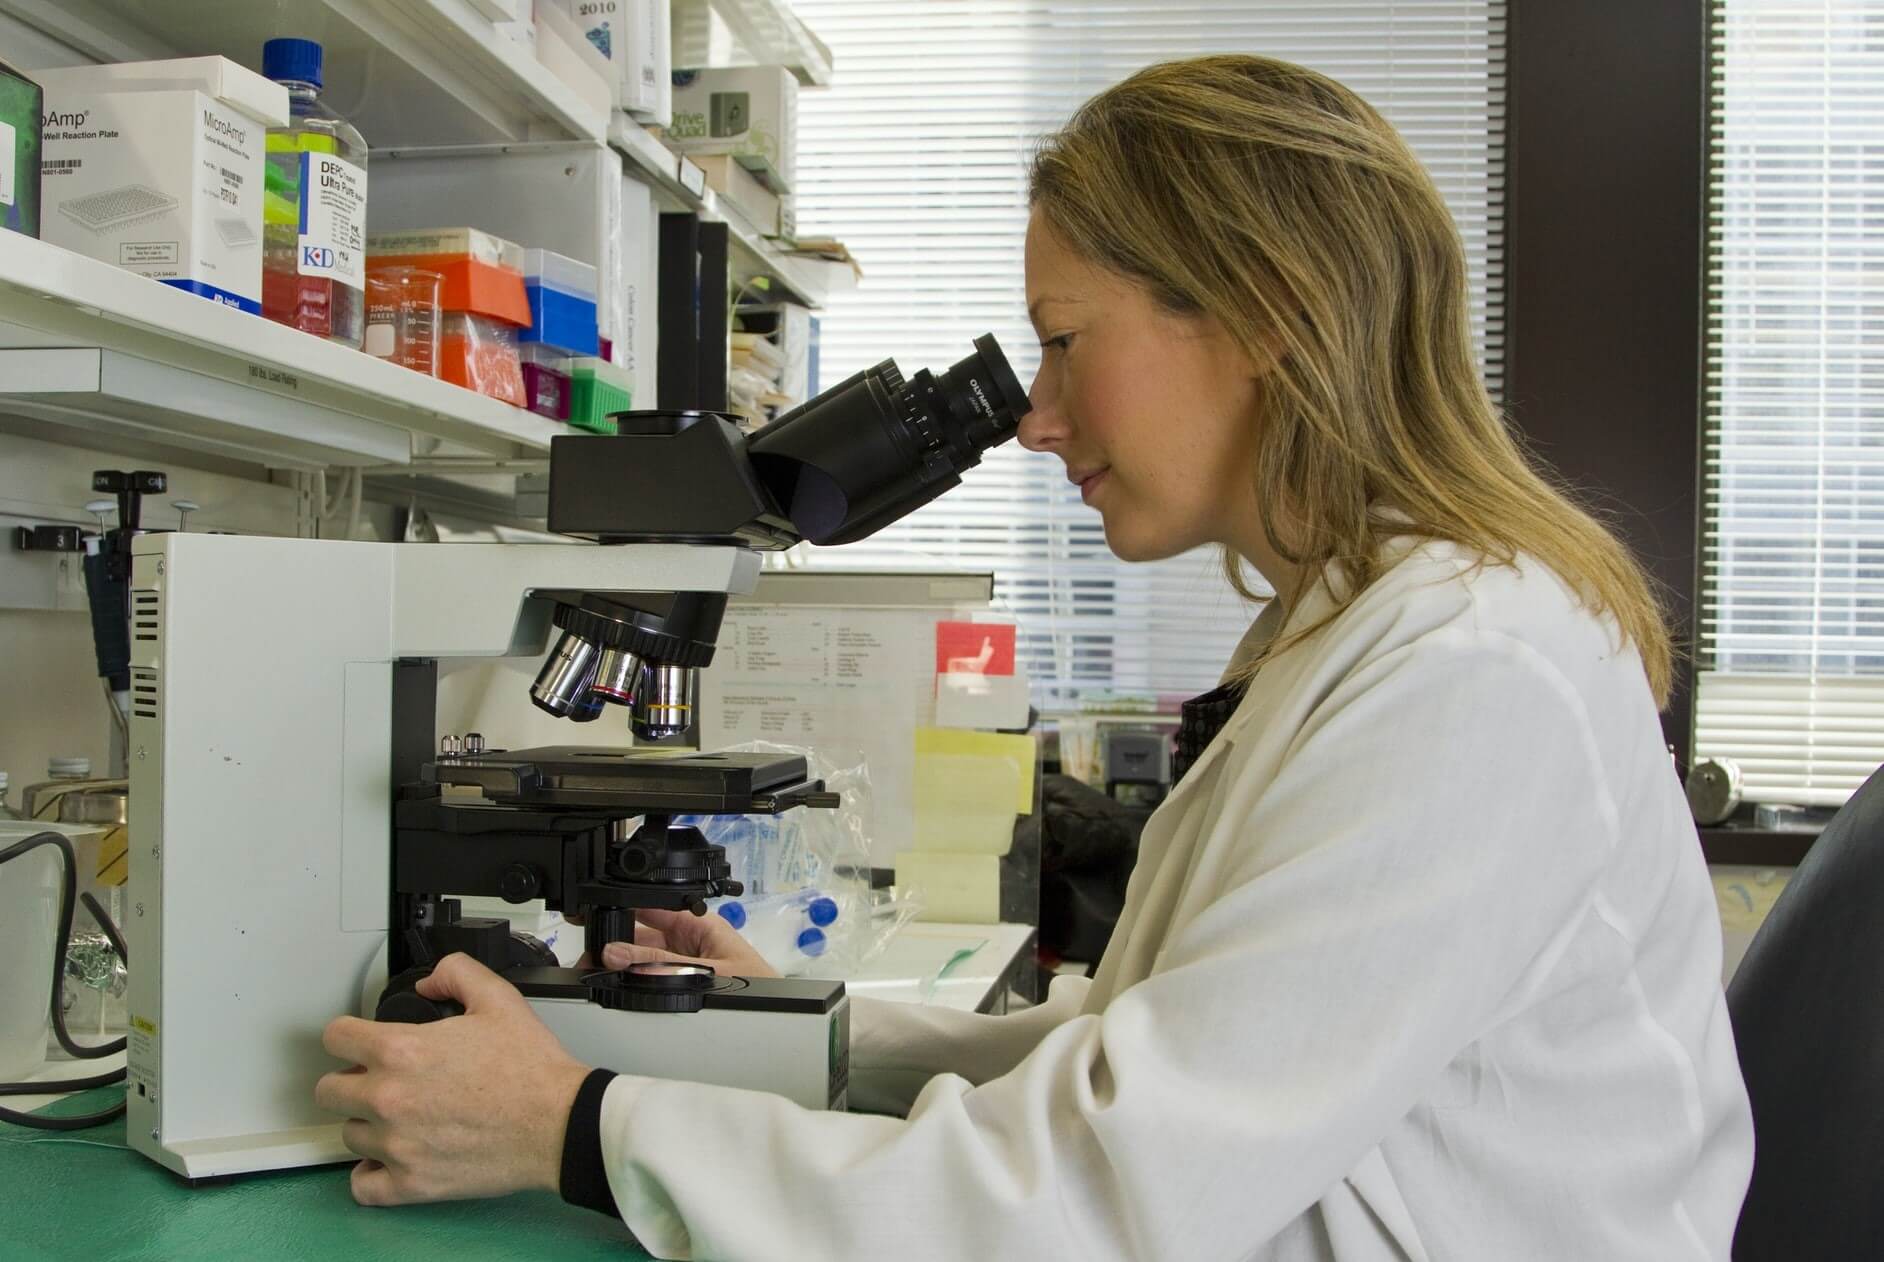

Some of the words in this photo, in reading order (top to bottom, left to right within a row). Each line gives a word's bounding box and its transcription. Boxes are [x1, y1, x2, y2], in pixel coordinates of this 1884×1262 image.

[579, 2, 616, 15] 2010
[62, 131, 96, 139] Reaction
[98, 130, 119, 138] Plate
[204, 109, 245, 145] MicroAmp
[321, 161, 344, 179] DEPC
[321, 175, 341, 192] Ultra
[341, 181, 355, 198] Pure
[969, 379, 995, 417] OLYMPUS
[57, 535, 64, 547] 3
